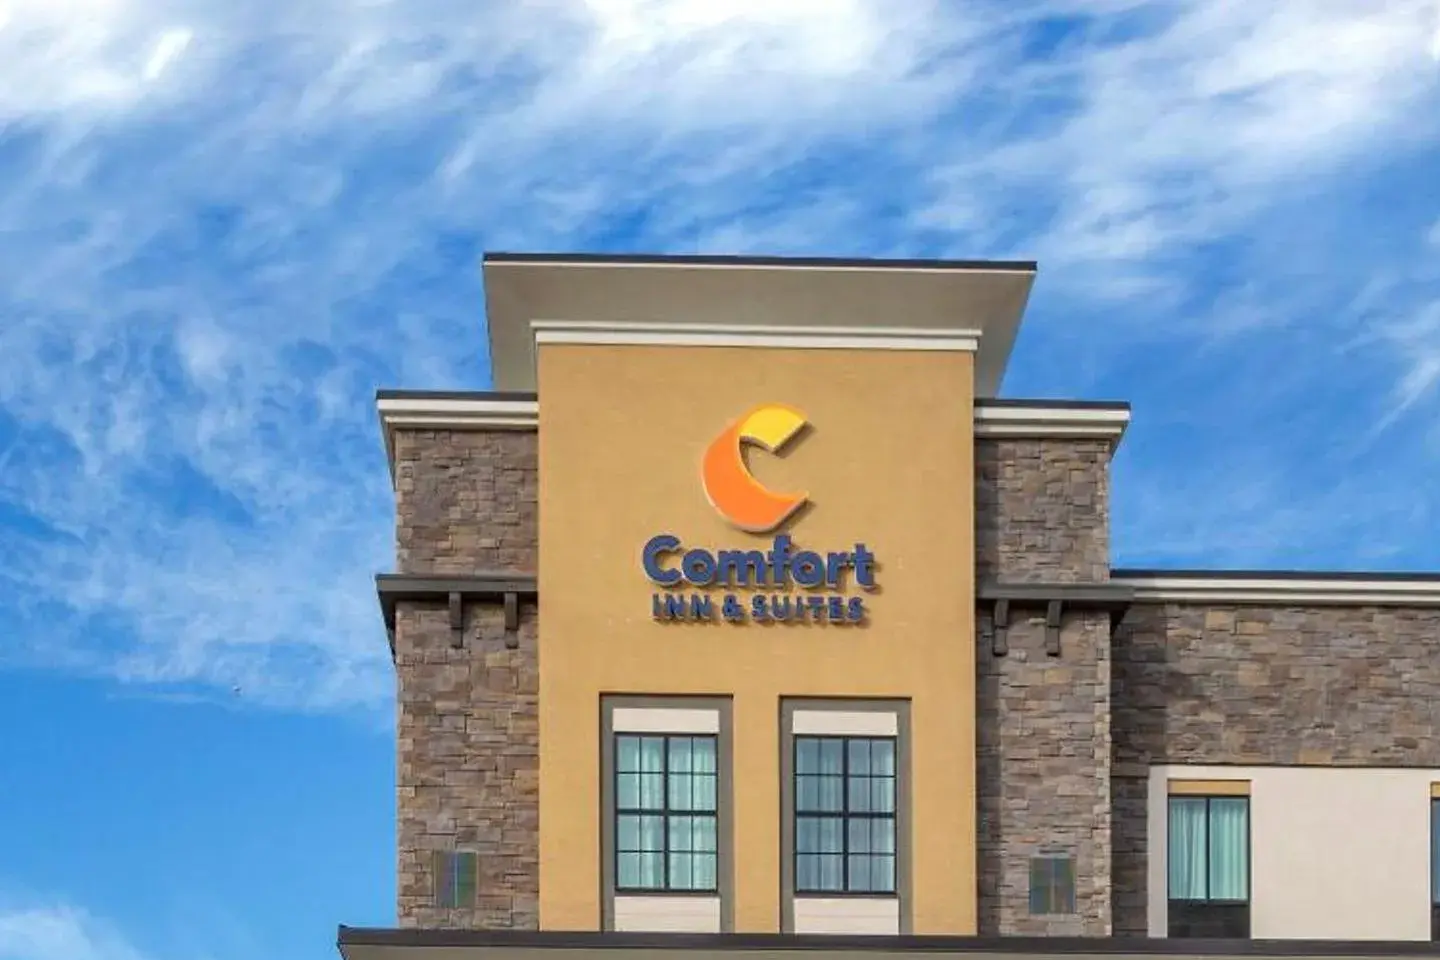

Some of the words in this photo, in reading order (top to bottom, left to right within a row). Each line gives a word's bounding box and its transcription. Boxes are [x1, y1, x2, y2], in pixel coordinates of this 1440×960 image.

[642, 533, 875, 587] Comfort
[652, 593, 713, 619] INN
[721, 594, 742, 621] &
[751, 594, 864, 622] SUITES
